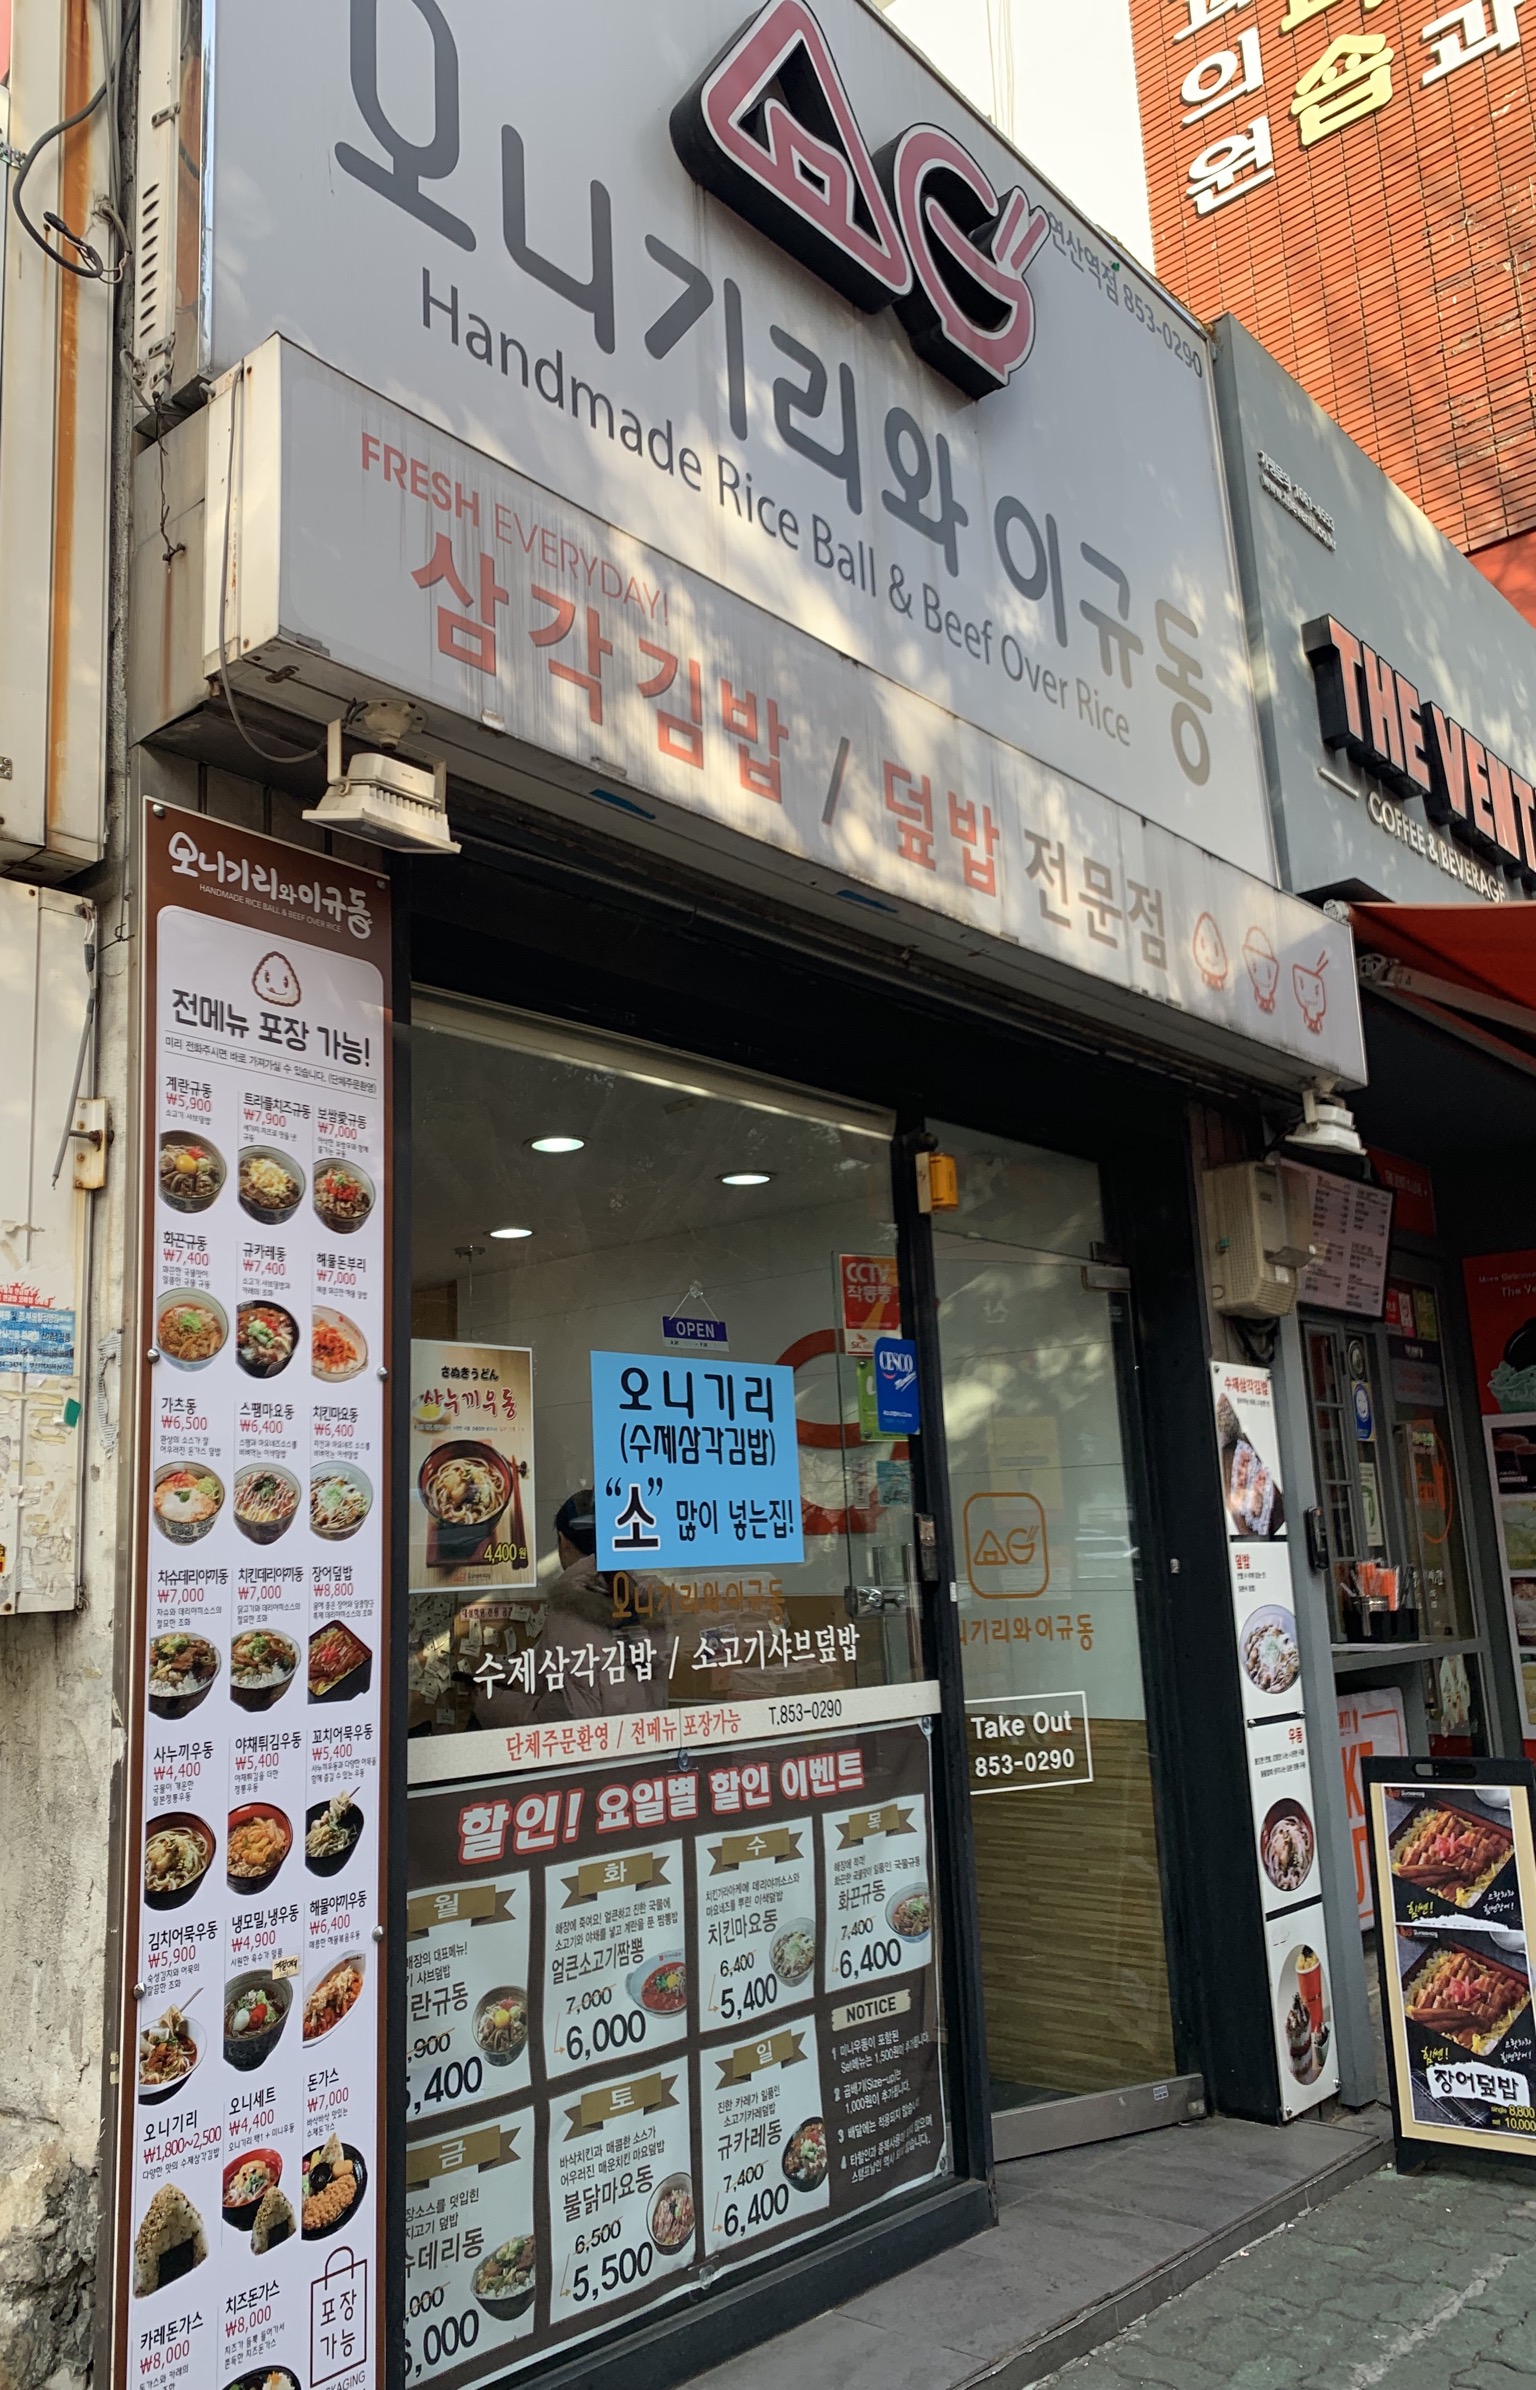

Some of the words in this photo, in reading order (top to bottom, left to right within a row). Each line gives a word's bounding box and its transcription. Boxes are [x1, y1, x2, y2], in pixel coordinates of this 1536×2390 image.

[1049, 212, 1119, 306] 연산역점
[1123, 284, 1202, 378] 853-0290
[335, 0, 968, 577] 오니기리와
[994, 496, 1212, 786] 이규동
[421, 267, 703, 491] Handmade
[718, 455, 799, 551] Rice
[812, 504, 876, 598] Ball
[888, 562, 913, 618] &
[923, 584, 992, 665] Beef
[1003, 634, 1071, 707] Over
[1076, 681, 1131, 748] Rice
[362, 432, 480, 529] FRESH
[494, 503, 669, 627] EVERYDAY!
[1328, 614, 1431, 793] THE
[410, 531, 789, 805] 삼각김밥
[821, 737, 850, 825] /
[883, 759, 1001, 898] 덮밥
[1023, 828, 1169, 972] 전문점
[1367, 791, 1427, 856] COFFEE
[1427, 832, 1438, 863] &
[1438, 840, 1506, 903] BEVERAGE
[168, 832, 373, 940] 오니기리와이규동
[200, 884, 244, 904] HANDMADE
[245, 898, 262, 909] RICE
[263, 903, 280, 914] BALL
[282, 908, 287, 916] &
[288, 911, 305, 920] BEEF
[306, 916, 326, 928] OVER
[326, 922, 341, 932] RICE
[172, 989, 249, 1038] 전메뉴
[258, 1011, 310, 1052] 포장
[317, 1026, 370, 1067] 가능!
[165, 1037, 183, 1050] 미리
[230, 1051, 247, 1064] 바로
[283, 1064, 291, 1074] 수
[166, 1077, 212, 1098] 계란규동
[243, 1092, 311, 1120] 트리플치즈규동
[166, 1092, 212, 1112] ₩5,900
[243, 1108, 287, 1128] ₩7,900
[318, 1121, 358, 1140] ₩7,000
[163, 1231, 208, 1251] 화끈규동
[243, 1243, 286, 1262] 규카레동
[316, 1253, 366, 1272] 해물돈부리
[163, 1249, 209, 1267] ₩7,400
[243, 1259, 286, 1276] ₩7,400
[317, 1270, 356, 1285] ₩7,000
[846, 1262, 889, 1284] CCTV
[676, 1321, 715, 1338] OPEN
[441, 1366, 499, 1381] さぬきうどん
[161, 1398, 197, 1415] 가츠동
[240, 1403, 294, 1420] 스팸마요동
[313, 1406, 358, 1422] 치킨마요동
[423, 1388, 517, 1420] 사누끼우동
[619, 1367, 774, 1423] 오니기리
[161, 1415, 208, 1431] ₩6,500
[240, 1419, 283, 1434] ₩6,400
[314, 1424, 354, 1437] ₩6,400
[620, 1422, 775, 1467] (수제삼각김밥)
[676, 1500, 718, 1542] 많이
[729, 1500, 794, 1541] 넣는집!
[158, 1588, 204, 1605] ₩7,000
[238, 1586, 281, 1601] ₩7,000
[314, 1583, 353, 1598] ₩8,800
[238, 1566, 304, 1583] 치킨데리야끼동
[312, 1566, 353, 1582] 장어덮밥
[473, 1639, 657, 1700] 수제삼각김밥
[668, 1636, 679, 1680] /
[690, 1623, 860, 1672] 소고기샤브덮밥
[154, 1741, 213, 1763] 사누끼우동
[235, 1731, 302, 1754] 야채튀김우동
[312, 1724, 373, 1744] 꼬치어묵우동
[505, 1722, 609, 1762] 단체주문환영
[630, 1717, 677, 1746] 전메뉴
[683, 1711, 741, 1739] 포장가능
[768, 1699, 842, 1726] T.853-0290
[971, 1716, 1026, 1740] Take
[1033, 1710, 1073, 1735] Out
[1288, 1726, 1303, 1745] 우동
[154, 1762, 200, 1781] ₩4,400
[235, 1753, 279, 1771] ₩5,400
[312, 1744, 353, 1761] ₩5,400
[974, 1748, 1076, 1778] 853-0290
[460, 1790, 584, 1862] 할인!
[597, 1775, 699, 1832] 요일별
[710, 1764, 771, 1813] 할인
[780, 1750, 864, 1799] 이벤트
[867, 1811, 881, 1829] 목
[746, 1836, 767, 1856] 수
[603, 1861, 628, 1883] 화
[433, 1893, 458, 1919] 월
[838, 1880, 886, 1912] 화끈규동
[148, 1920, 218, 1950] 김치어묵우동
[232, 1904, 299, 1933] 냉모밀,냉우동
[310, 1890, 367, 1917] 해물야끼우동
[707, 1908, 778, 1947] 치킨마요동
[840, 1917, 874, 1940] 7,400
[148, 1945, 196, 1969] ₩5,900
[232, 1930, 276, 1953] ₩4,900
[310, 1914, 351, 1935] ₩6,400
[552, 1937, 645, 1985] 얼큰소고기짬뽕
[840, 1938, 901, 1980] 6,400
[720, 1952, 755, 1978] 6,400
[565, 1986, 613, 2015] 7,000
[720, 1973, 777, 2019] 5,400
[846, 1996, 896, 2023] NOTICE
[567, 2010, 646, 2061] 6,000
[756, 2040, 773, 2065] 일
[609, 2087, 635, 2111] 토
[1434, 2067, 1519, 2099] 장어덮밥
[143, 2110, 198, 2142] 오니기리
[228, 2087, 276, 2115] 오니세트
[308, 2068, 340, 2092] 돈가스
[229, 2109, 274, 2136] ₩4,400
[308, 2087, 349, 2113] ₩7,000
[717, 2098, 733, 2114] 진한
[735, 2092, 759, 2111] 카레가
[723, 2103, 776, 2128] 소고기카레덮밥
[1509, 2104, 1536, 2119] 8,800
[438, 2140, 466, 2170] 금
[559, 2147, 603, 2169] 바삭치킨과
[633, 2126, 656, 2146] 소스가
[718, 2119, 783, 2161] 규카레동
[563, 2164, 654, 2223] 불닭마요동
[723, 2163, 764, 2194] 7,400
[439, 2212, 459, 2232] 덮밥
[724, 2184, 789, 2237] 6,400
[575, 2220, 622, 2255] 6,500
[573, 2242, 653, 2302] 5,500
[140, 2312, 204, 2350] 카레돈가스
[226, 2280, 281, 2315] 치즈돈가스
[320, 2289, 357, 2327] 포장
[140, 2340, 190, 2375] ₩8,000
[225, 2305, 272, 2338] ₩8,000
[320, 2329, 356, 2360] 가능
